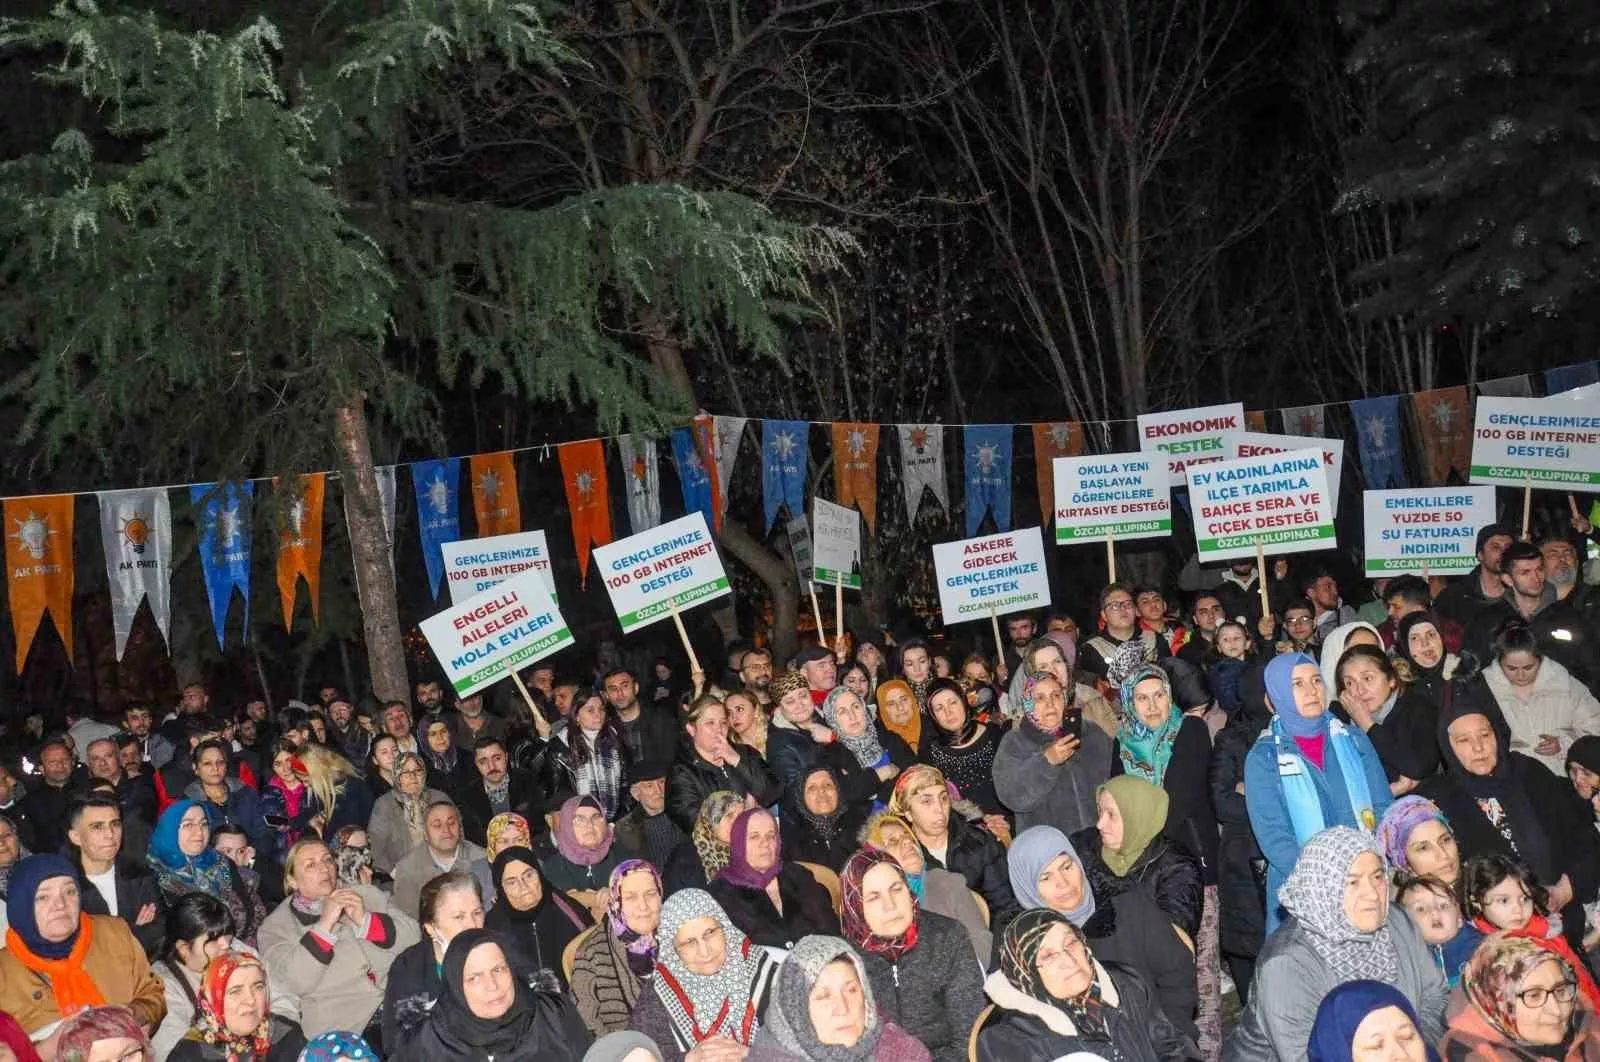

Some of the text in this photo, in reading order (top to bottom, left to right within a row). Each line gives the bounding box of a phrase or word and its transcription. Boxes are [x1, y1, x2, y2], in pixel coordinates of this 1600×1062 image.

[1476, 429, 1500, 439] 100
[1506, 430, 1526, 440] GB
[1078, 465, 1118, 476] OKULA
[1192, 473, 1212, 486] EV
[1216, 458, 1320, 482] KADINLARINA
[1532, 469, 1590, 482] ULUPINAR
[1080, 476, 1142, 489] BAŞLAYAN
[1243, 478, 1310, 496] TARIMLA
[1202, 492, 1320, 518] BAHÇE SERA VE
[1445, 511, 1464, 522] 50
[1260, 528, 1320, 545] ULUPINAR
[1382, 526, 1474, 540] SU FATURASI
[964, 537, 1014, 554] ASKERE
[120, 560, 132, 571] AK
[1426, 557, 1480, 568] ULUPINA
[448, 570, 468, 581] 100
[472, 568, 488, 578] GB
[607, 574, 630, 590] 100
[633, 566, 652, 580] GB
[970, 580, 1018, 598] DESTEK
[451, 642, 497, 670] MOLA
[509, 634, 559, 666] ULUPINAR
